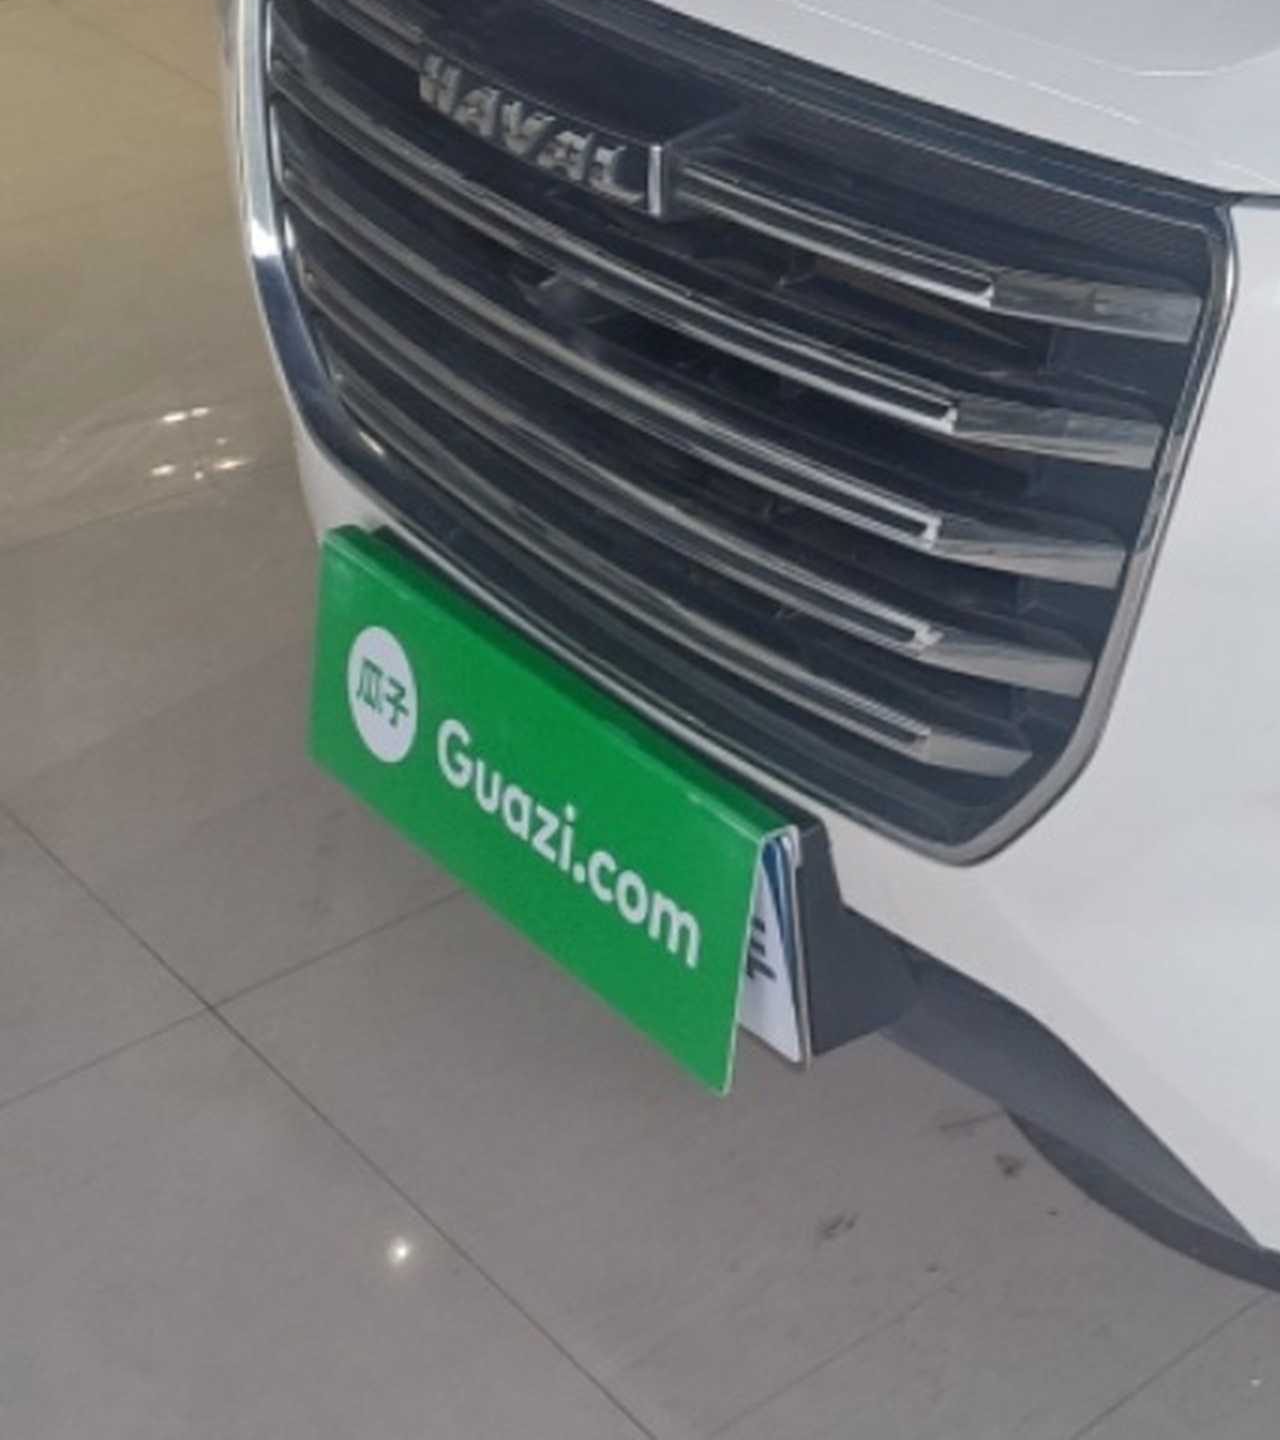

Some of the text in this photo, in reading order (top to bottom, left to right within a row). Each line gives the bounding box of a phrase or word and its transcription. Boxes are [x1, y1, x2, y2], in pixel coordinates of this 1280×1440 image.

[418, 55, 646, 206] HAVAL
[356, 656, 409, 728] 瓜子
[437, 719, 701, 968] Guazi.com
